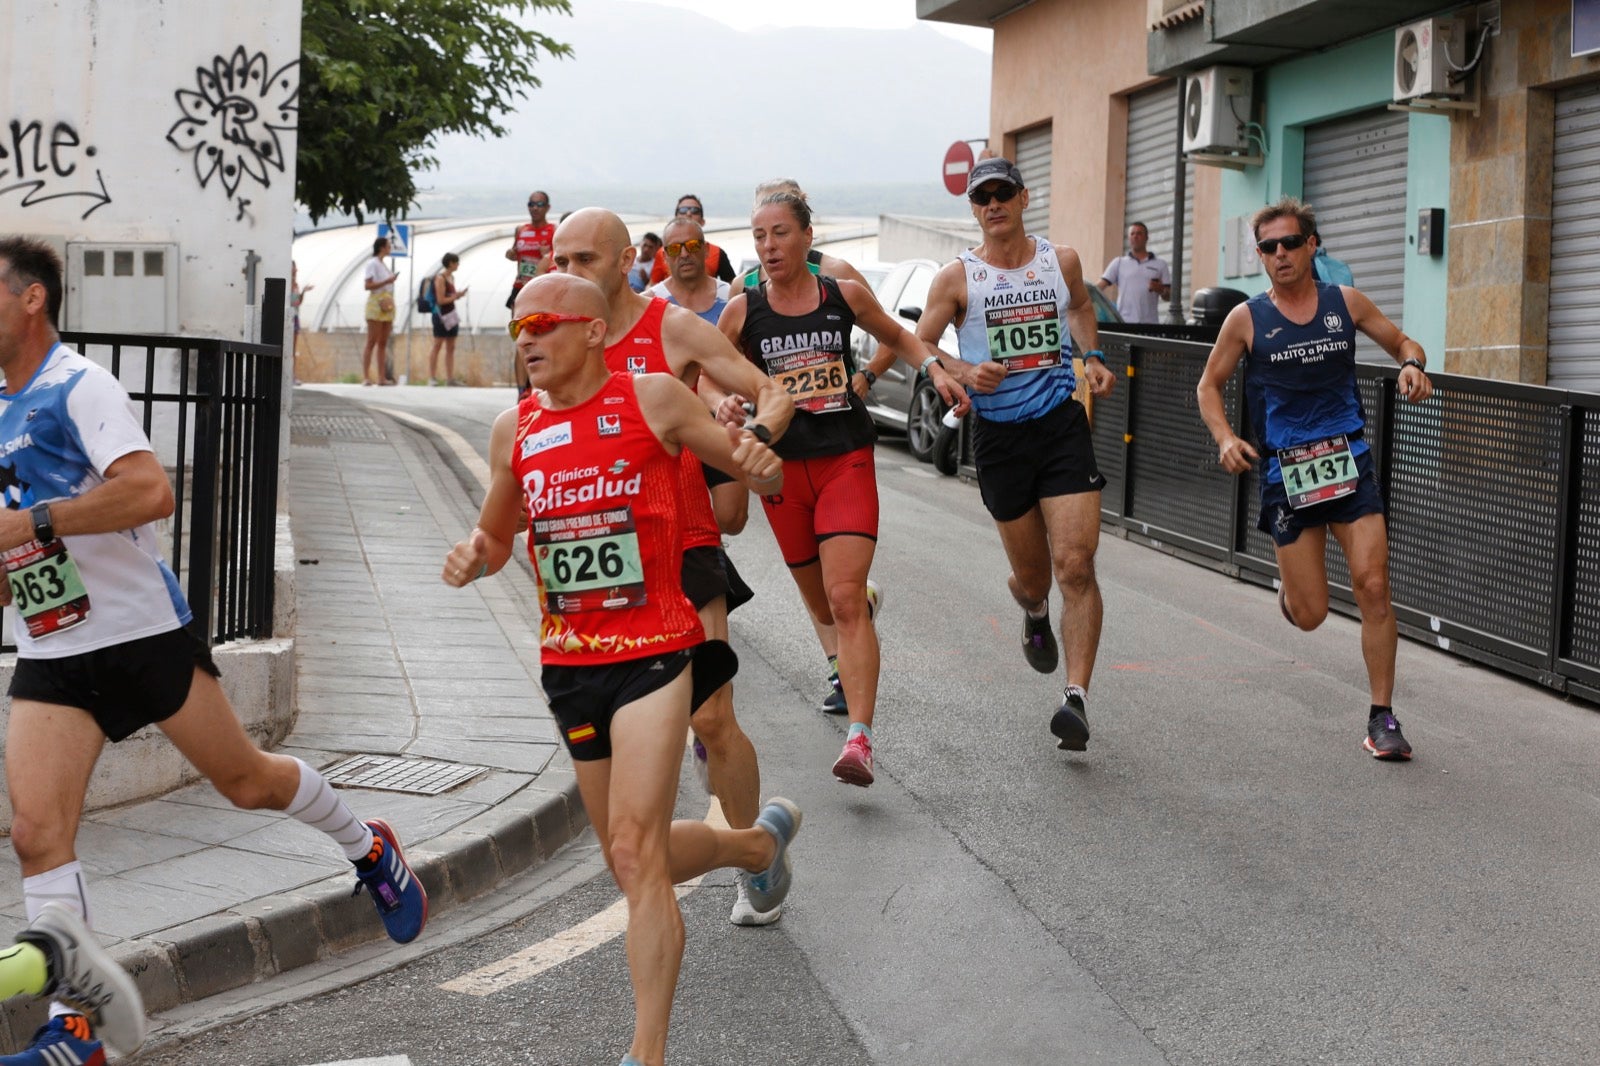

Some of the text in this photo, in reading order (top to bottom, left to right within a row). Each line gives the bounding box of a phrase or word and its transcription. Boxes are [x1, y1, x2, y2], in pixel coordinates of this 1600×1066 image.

[984, 288, 1057, 308] MARACENA
[1327, 315, 1339, 327] 30
[760, 330, 843, 354] GRANADA
[994, 323, 1059, 352] 1055
[1270, 340, 1348, 363] PAZITO a PAZITO
[1301, 354, 1324, 364] Motril
[782, 366, 843, 395] 2256
[550, 466, 600, 485] Clínicas
[1289, 455, 1349, 489] 1137
[522, 469, 642, 518] Polisalud
[553, 541, 624, 585] 626
[12, 564, 67, 611] 963
